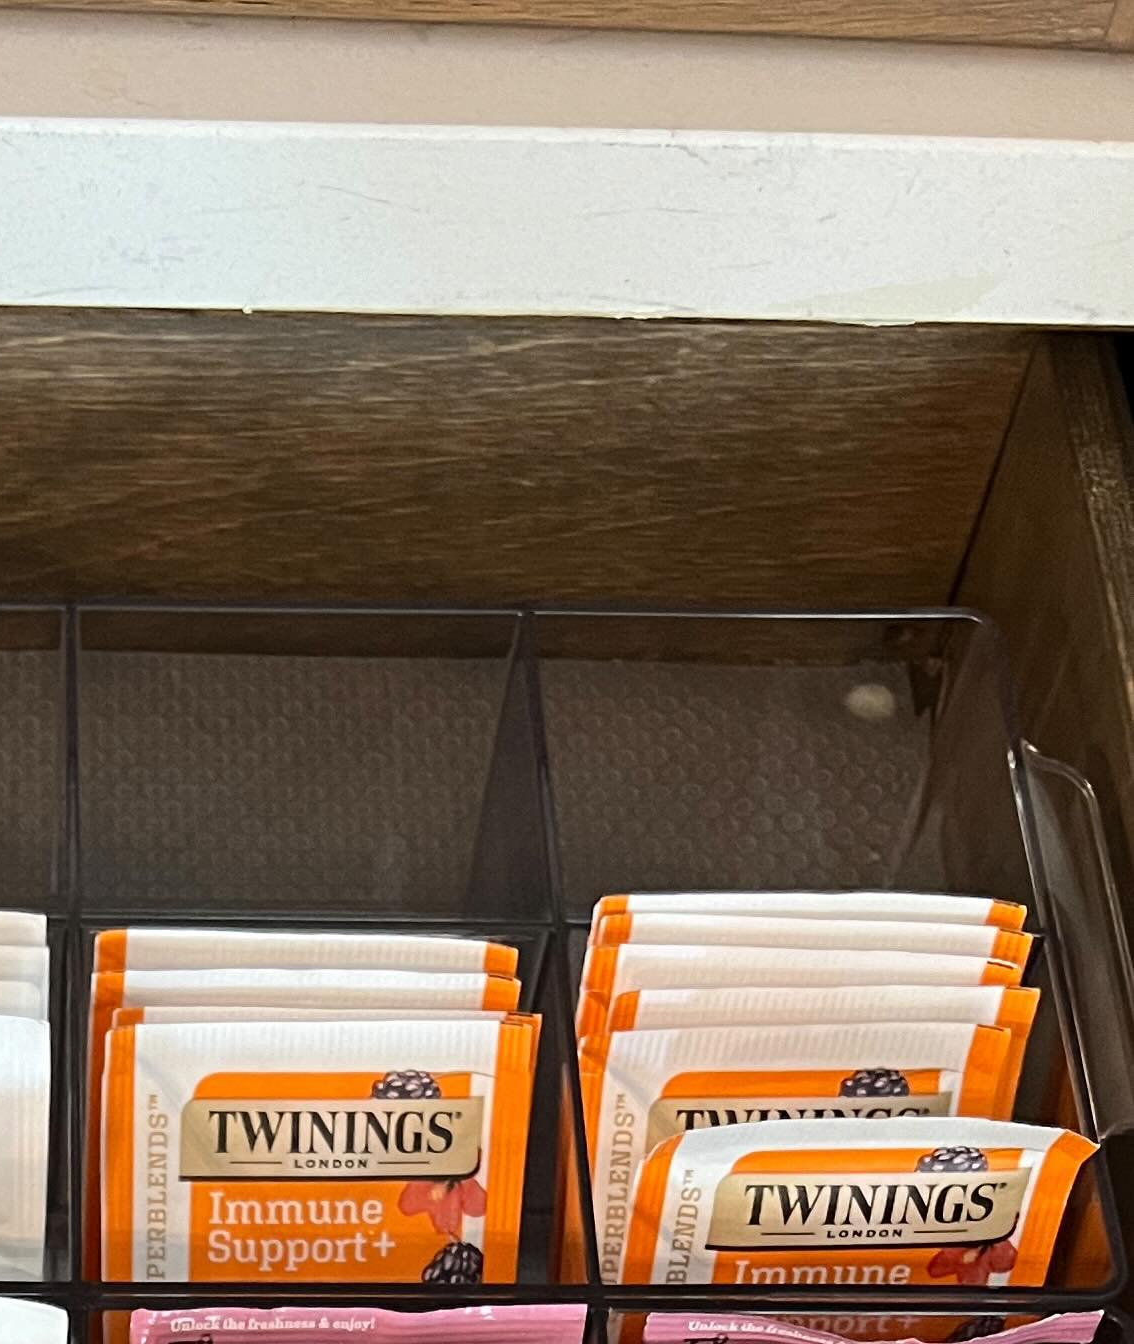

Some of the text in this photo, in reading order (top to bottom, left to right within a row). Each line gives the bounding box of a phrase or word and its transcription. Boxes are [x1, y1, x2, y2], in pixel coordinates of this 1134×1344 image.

[294, 1159, 367, 1169] LONDON
[209, 1192, 383, 1224] Immune
[208, 1230, 395, 1271] Support+
